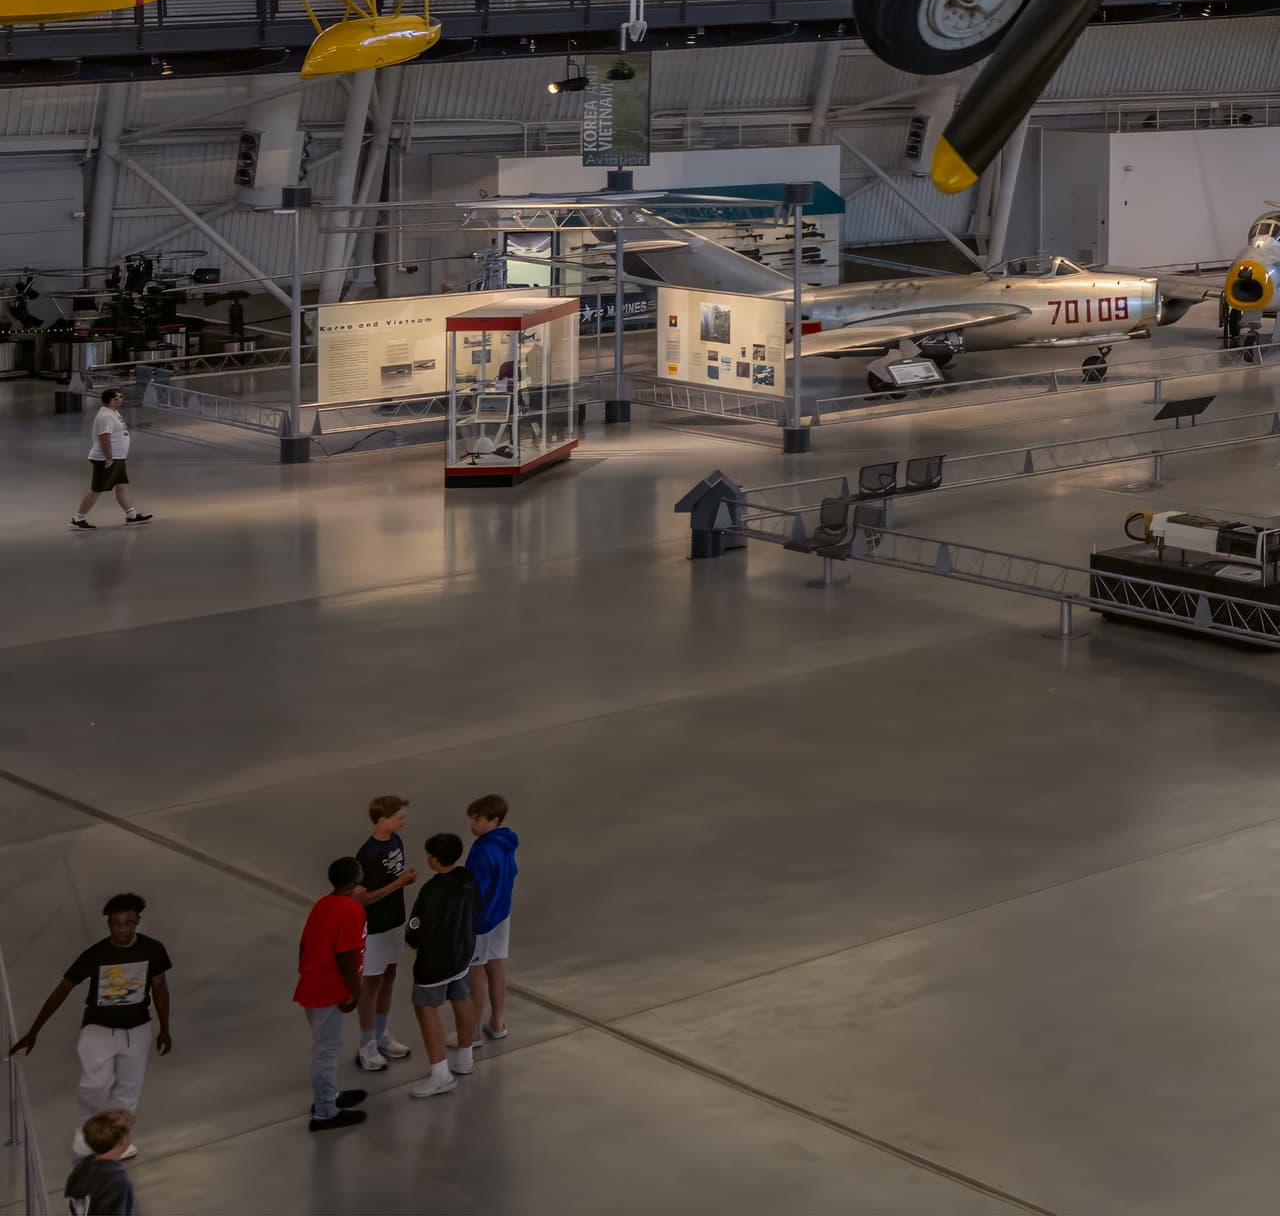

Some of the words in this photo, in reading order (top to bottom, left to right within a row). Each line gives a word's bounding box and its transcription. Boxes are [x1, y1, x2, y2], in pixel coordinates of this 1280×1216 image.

[583, 100, 598, 152] KOREA
[598, 83, 613, 152] VIETNAM
[320, 323, 353, 332] Korea
[385, 317, 433, 326] Vietnam
[1047, 296, 1129, 325] 70109
